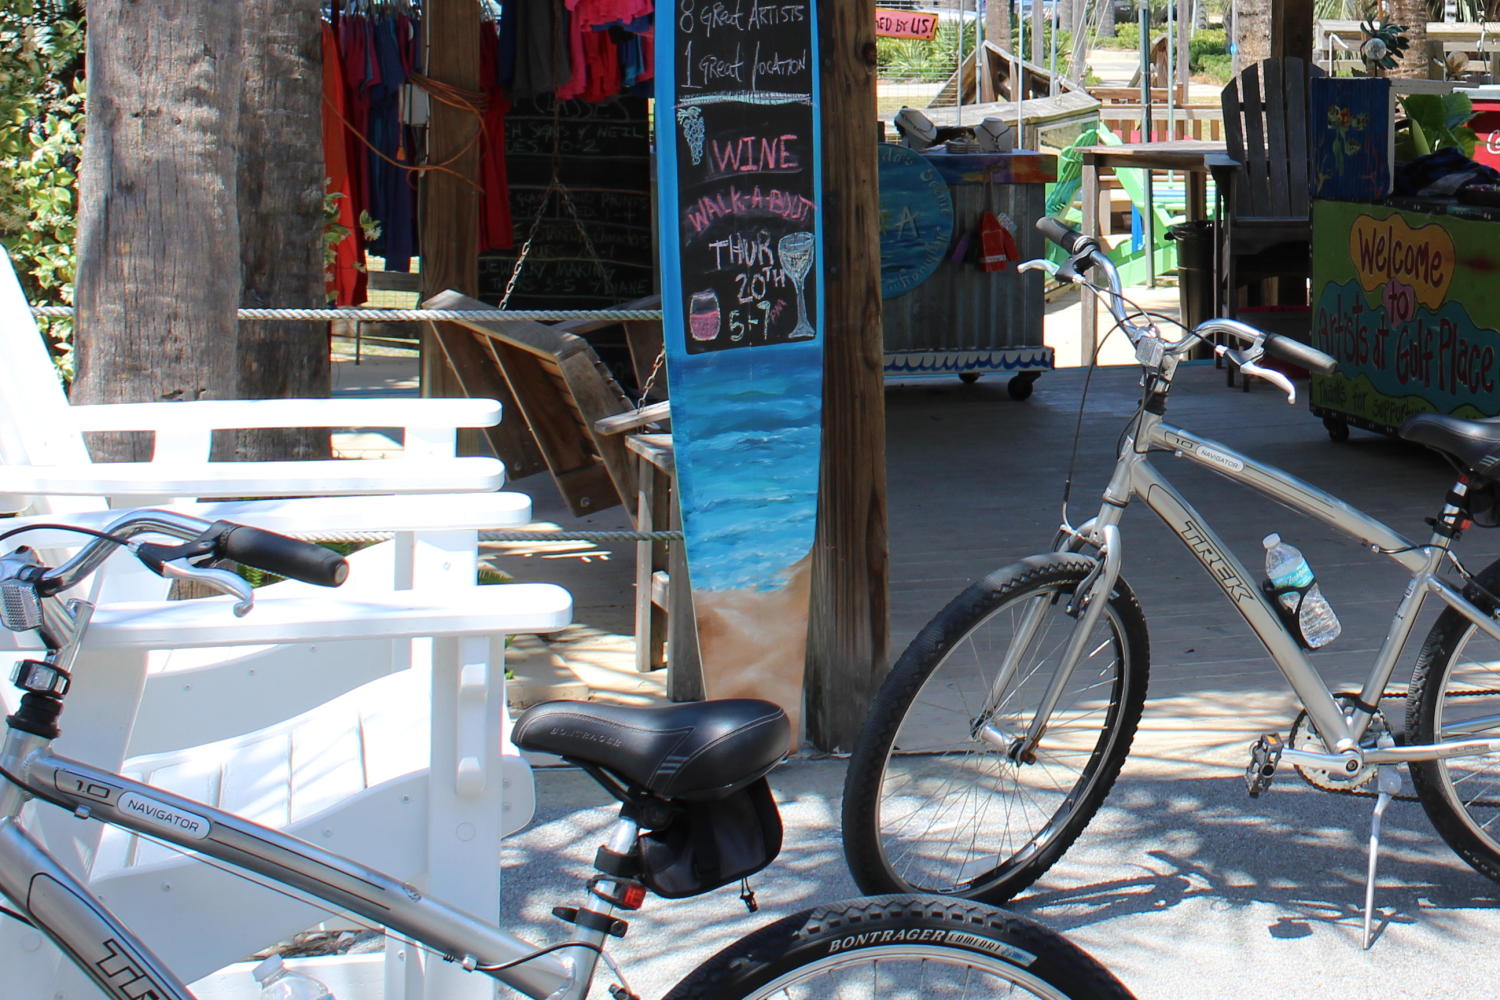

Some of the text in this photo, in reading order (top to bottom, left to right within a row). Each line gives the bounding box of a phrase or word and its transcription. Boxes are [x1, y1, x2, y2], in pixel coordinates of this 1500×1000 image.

[910, 17, 936, 39] US!
[711, 134, 799, 172] WINE
[709, 230, 774, 270] THUR
[1358, 227, 1444, 288] Welcome
[1388, 282, 1411, 324] to
[1396, 317, 1433, 386] Gulf
[1440, 317, 1496, 394] Place
[1200, 449, 1240, 470] NAVIGATOR
[1180, 520, 1254, 602] TREK
[75, 778, 111, 800] 1.0
[126, 796, 201, 834] NAVIGATOR
[828, 928, 946, 954] BONTRAGER
